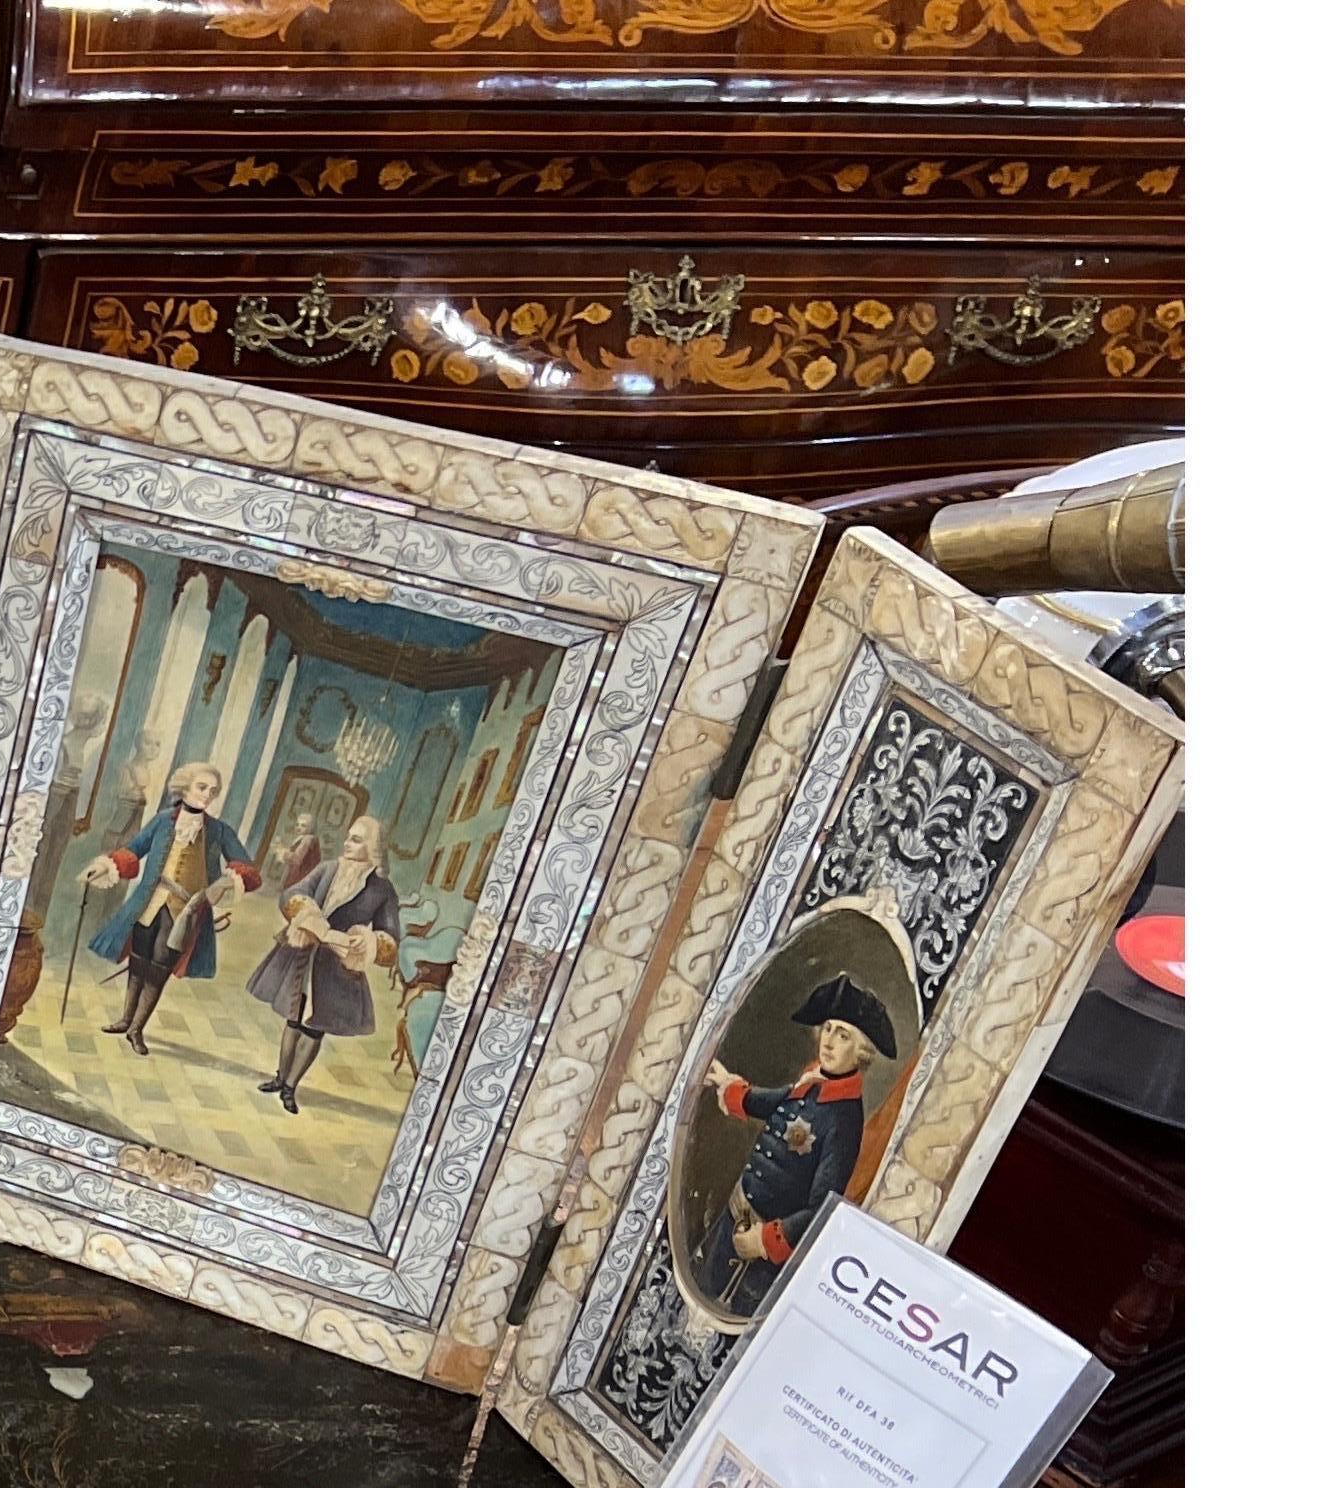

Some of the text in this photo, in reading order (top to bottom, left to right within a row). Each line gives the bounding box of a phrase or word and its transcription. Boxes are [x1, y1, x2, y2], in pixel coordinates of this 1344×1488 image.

[818, 1282, 999, 1410] CENTROSTUDIARCHEOMETRICI
[831, 1255, 1018, 1398] CESAR
[782, 1385, 840, 1431] CERTIFICATO
[840, 1427, 853, 1440] DI
[783, 1404, 899, 1488] CERTIFICATE OF AUTHENTICITY
[855, 1399, 877, 1419] DFA
